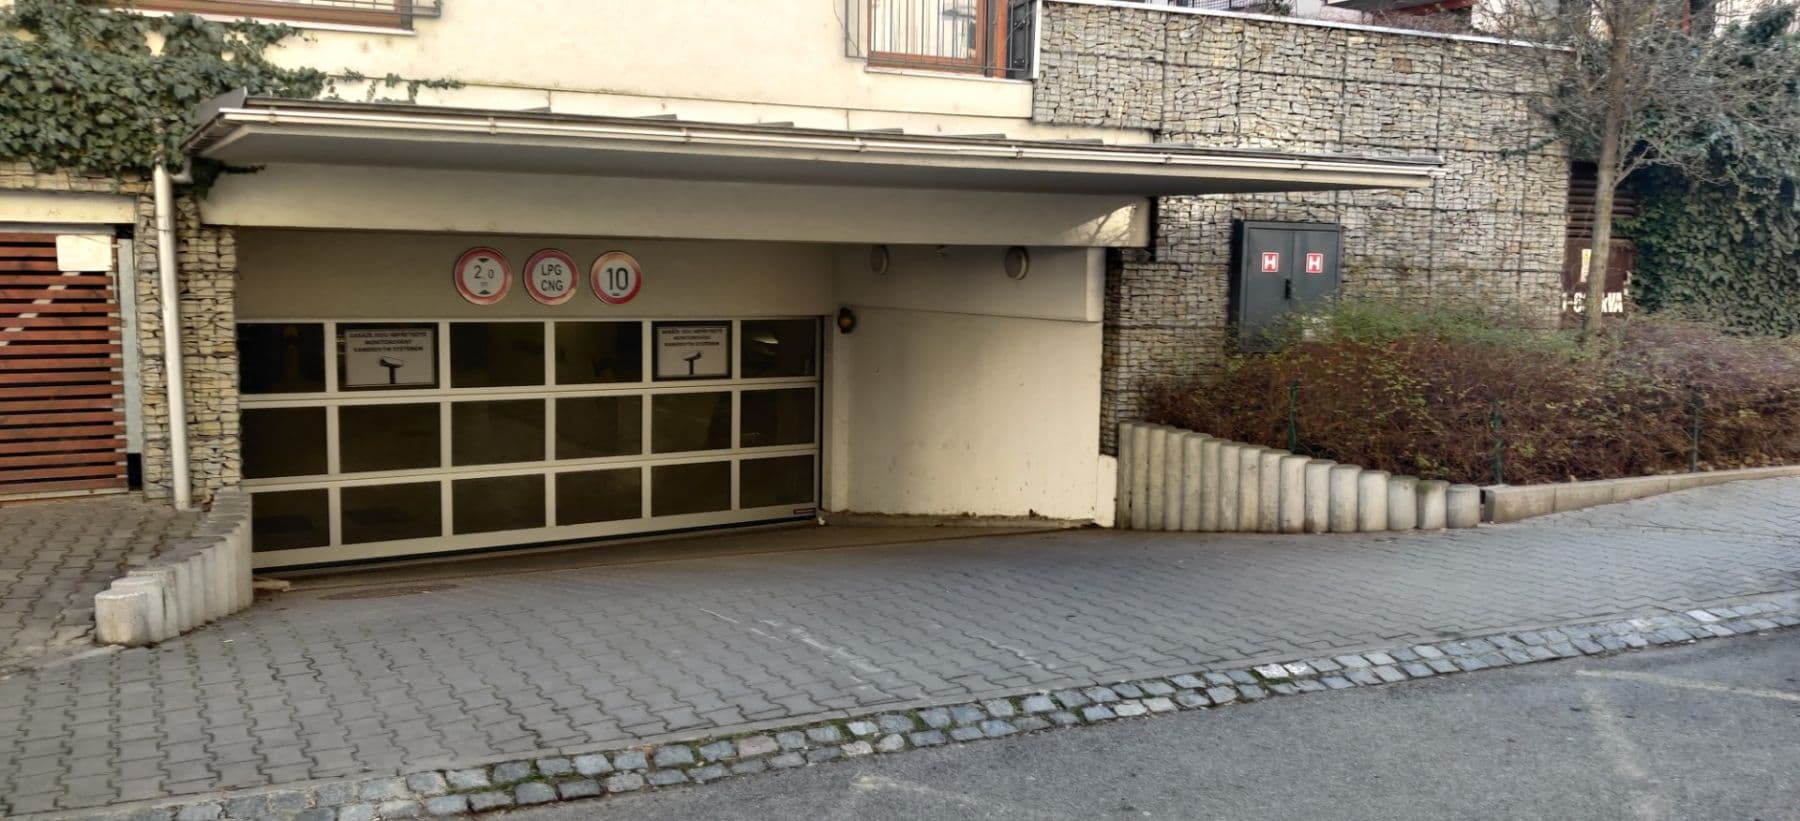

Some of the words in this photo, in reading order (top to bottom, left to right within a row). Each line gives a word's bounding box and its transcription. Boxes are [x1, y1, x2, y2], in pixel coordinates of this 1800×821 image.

[541, 264, 562, 277] LPG
[1263, 255, 1277, 271] H
[1308, 256, 1322, 272] H
[541, 279, 564, 292] CNG
[606, 267, 629, 291] 10
